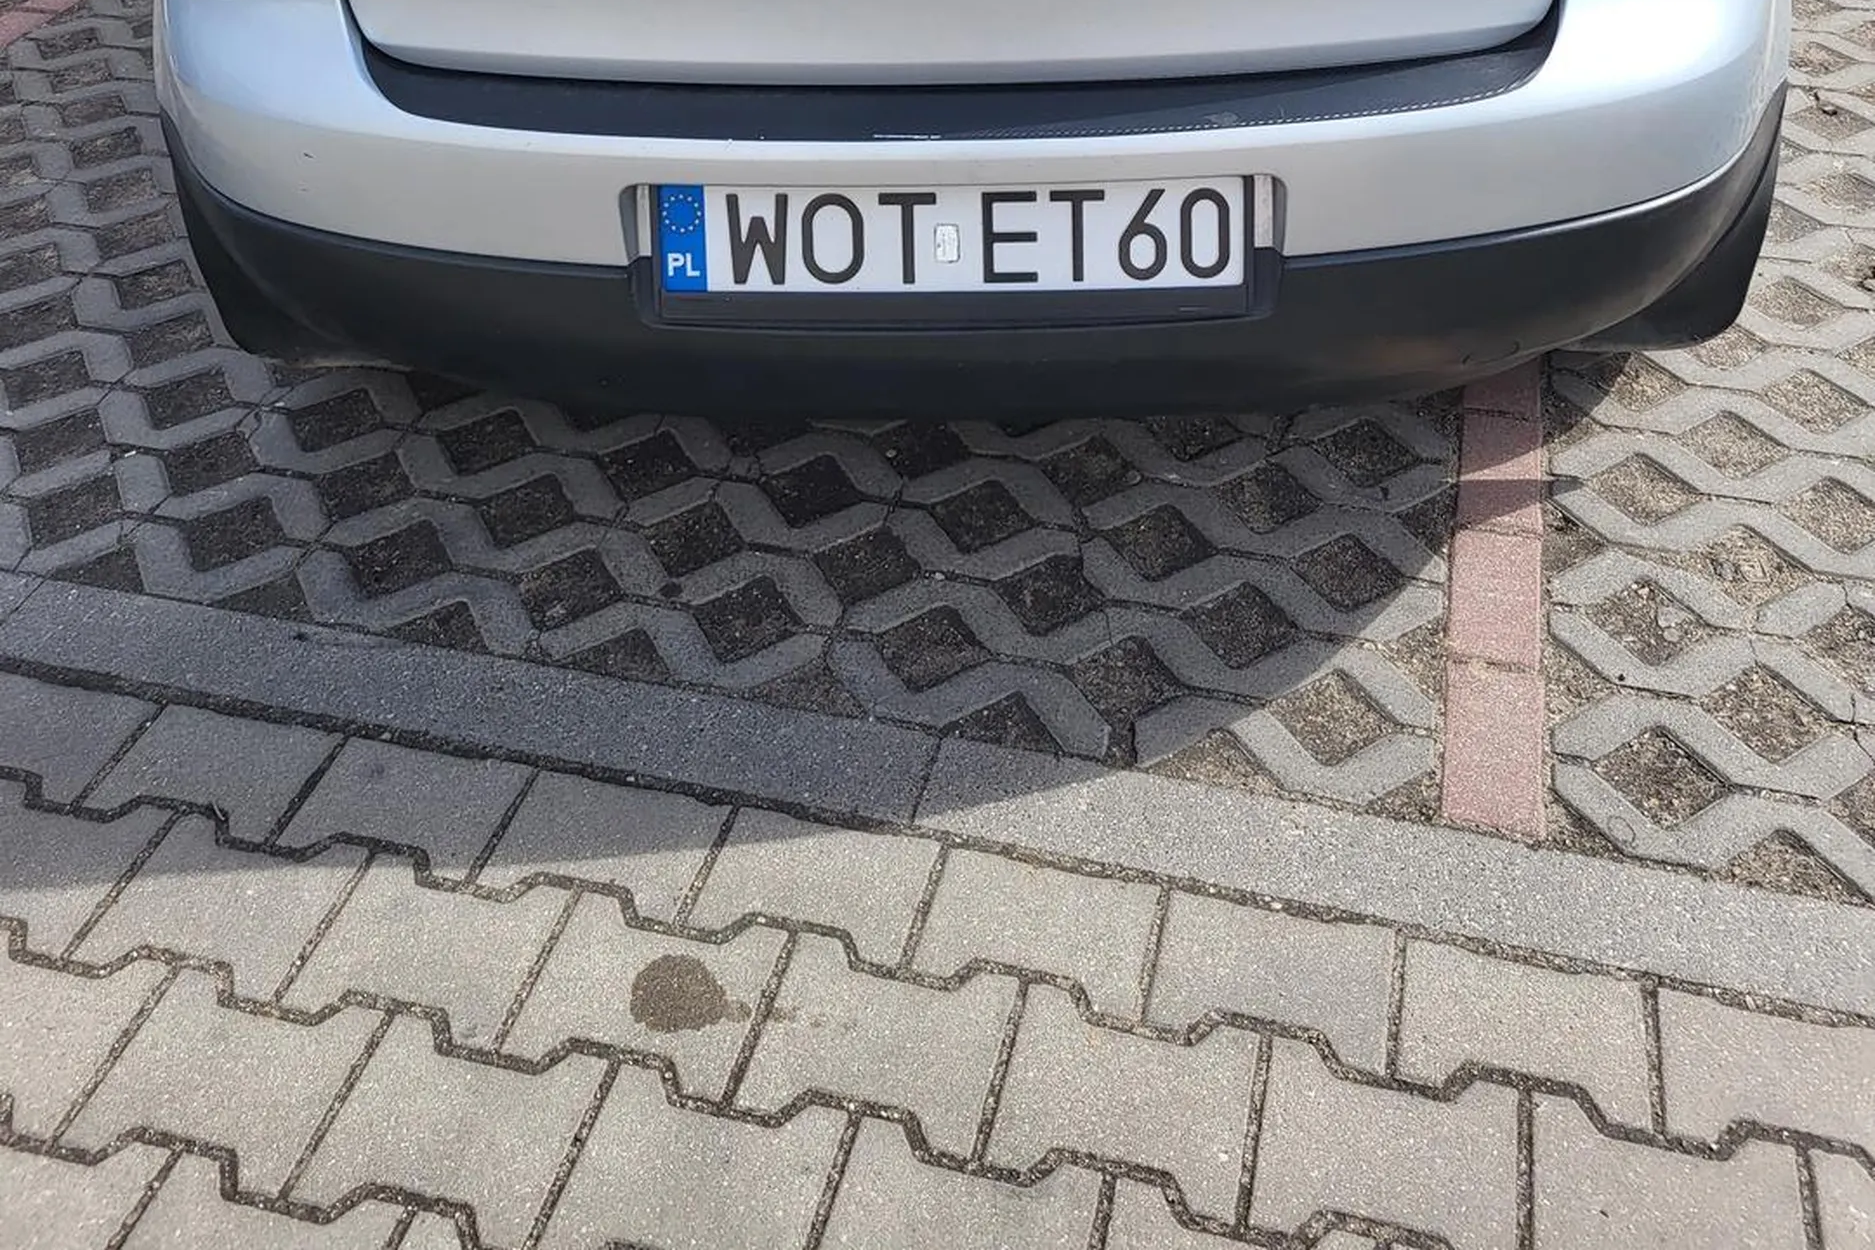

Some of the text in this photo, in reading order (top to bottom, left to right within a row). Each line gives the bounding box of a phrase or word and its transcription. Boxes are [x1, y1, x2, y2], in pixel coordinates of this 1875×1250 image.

[667, 252, 701, 277] PL
[726, 187, 1231, 285] WOT ET60
